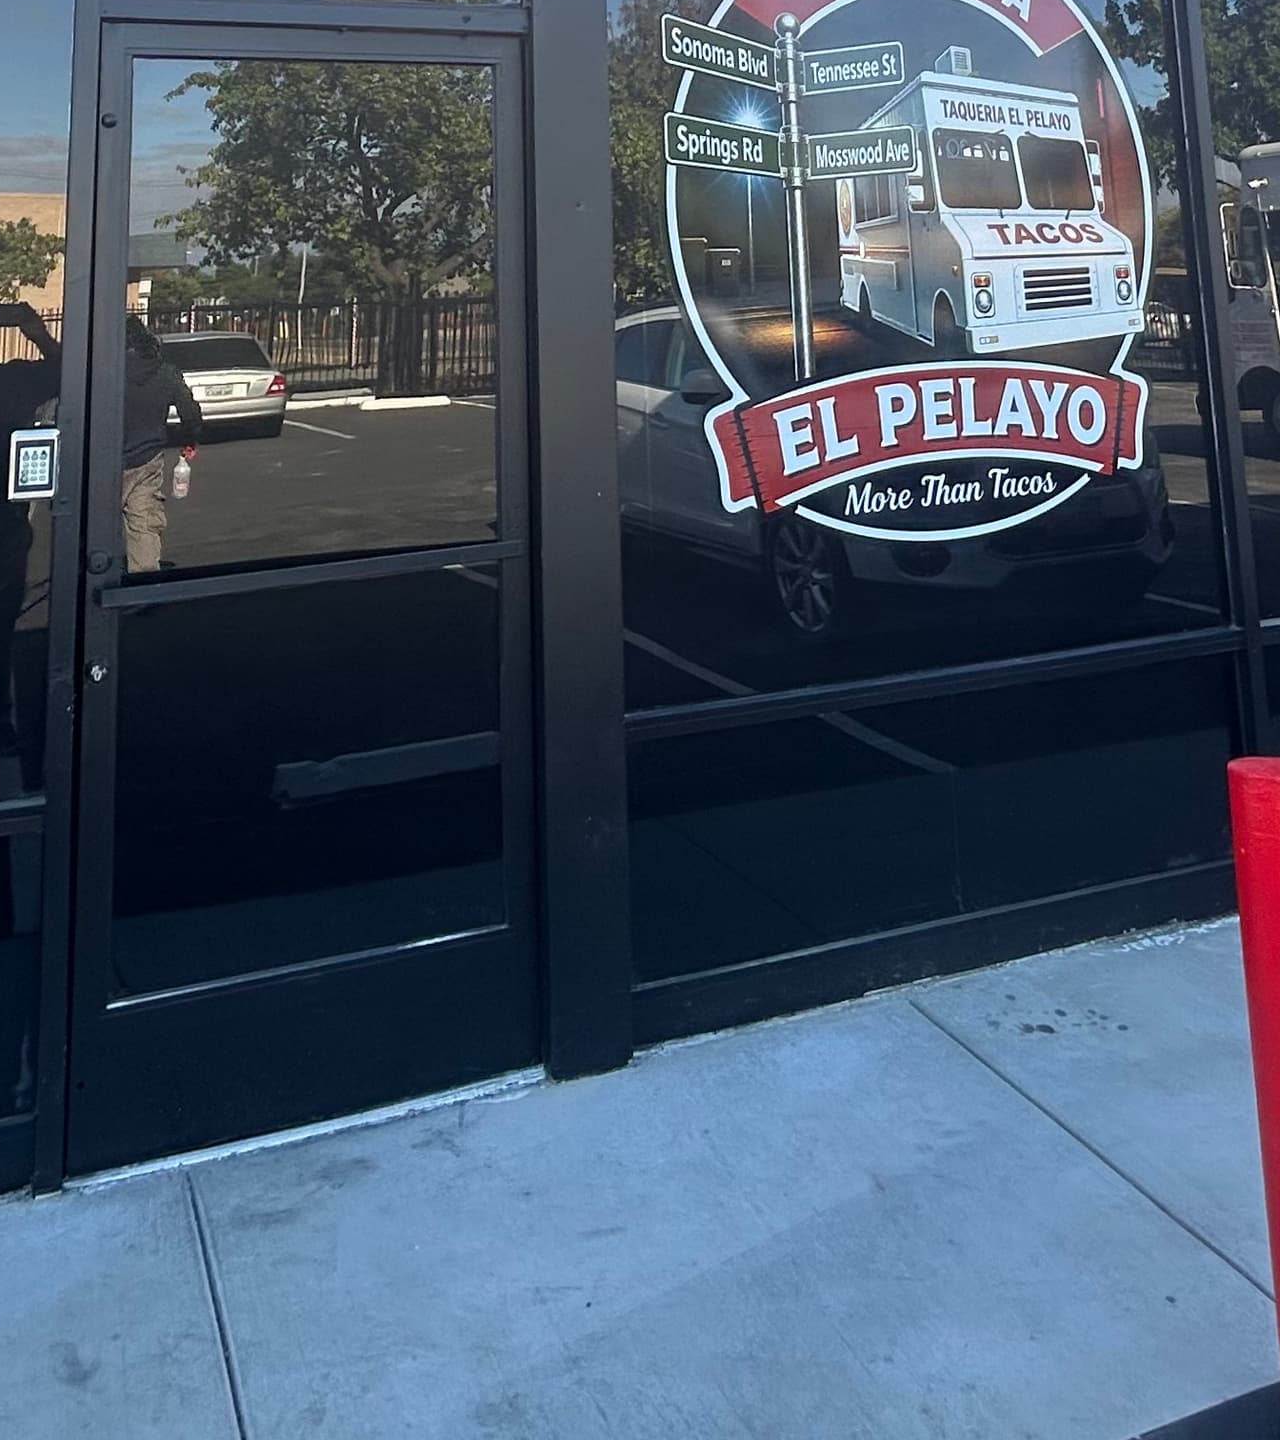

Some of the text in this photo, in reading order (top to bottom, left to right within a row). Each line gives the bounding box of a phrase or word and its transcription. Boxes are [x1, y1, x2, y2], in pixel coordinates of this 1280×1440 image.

[671, 27, 769, 78] Sonoma Blvd
[810, 53, 897, 84] Tennessee St
[940, 99, 1071, 132] TAQUERIA EL PELAYO
[676, 125, 763, 164] Springs Rd
[815, 139, 910, 169] Mosswood Ave
[986, 222, 1105, 246] TACOS
[773, 377, 1107, 477] EL PELAYO
[844, 468, 1058, 517] More Than Tacos
